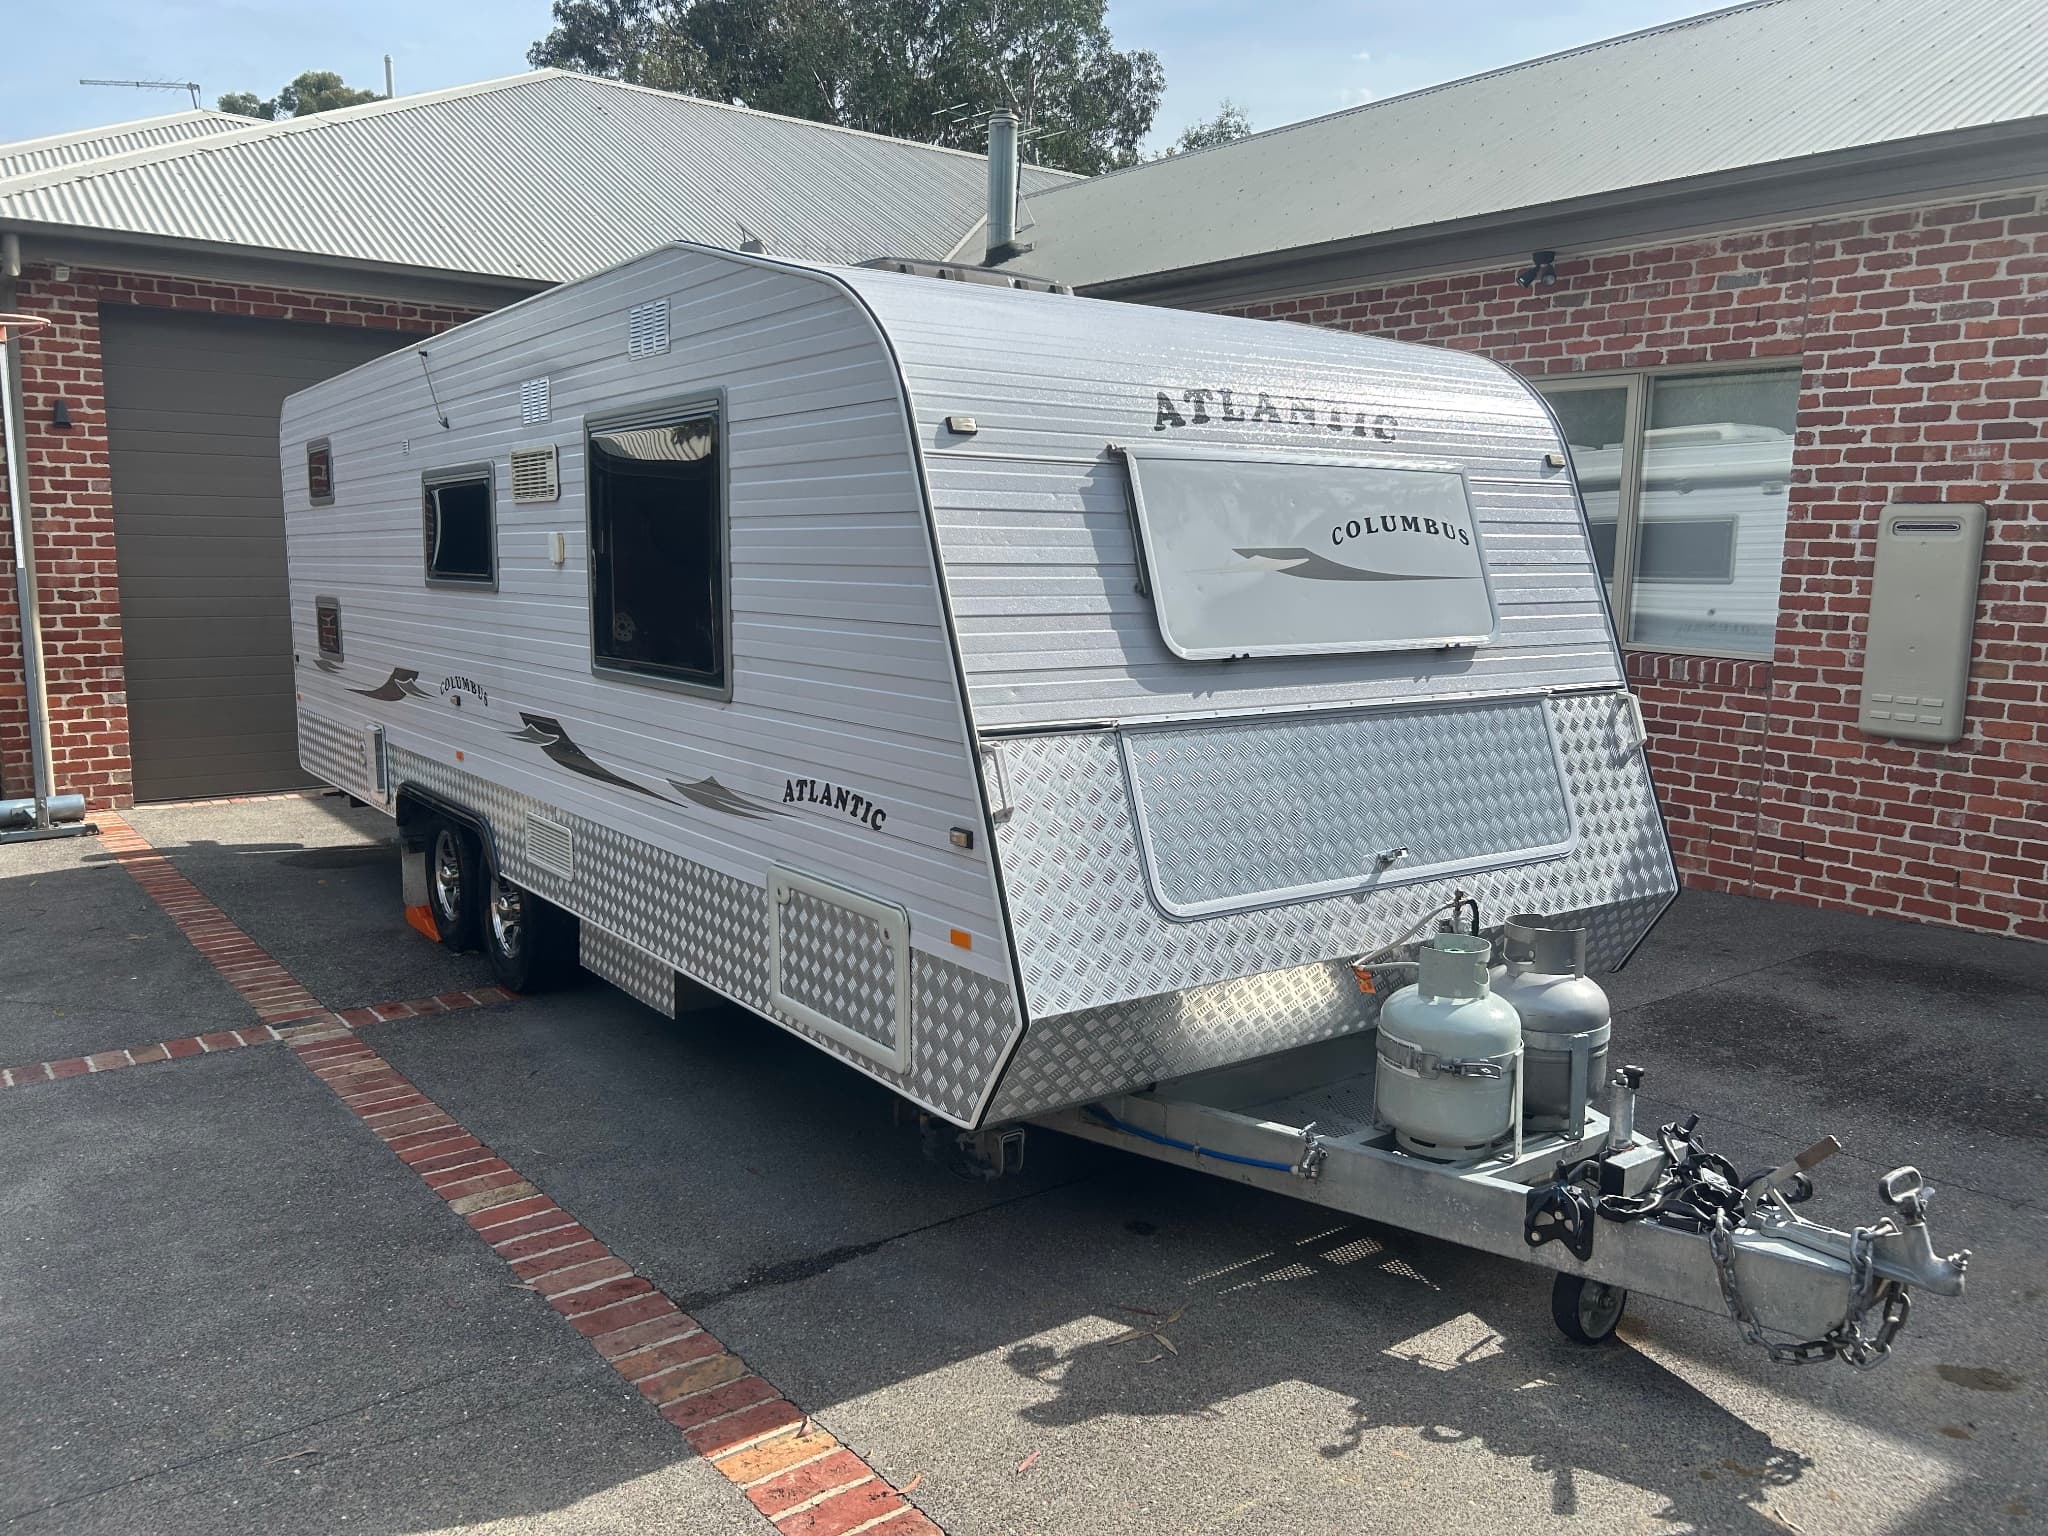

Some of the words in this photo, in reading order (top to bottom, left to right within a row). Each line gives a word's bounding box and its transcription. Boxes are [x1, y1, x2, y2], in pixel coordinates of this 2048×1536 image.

[1331, 515, 1470, 546] COLUMBUS
[440, 676, 488, 706] COLUMBUS
[782, 779, 887, 831] ATLANTIC
